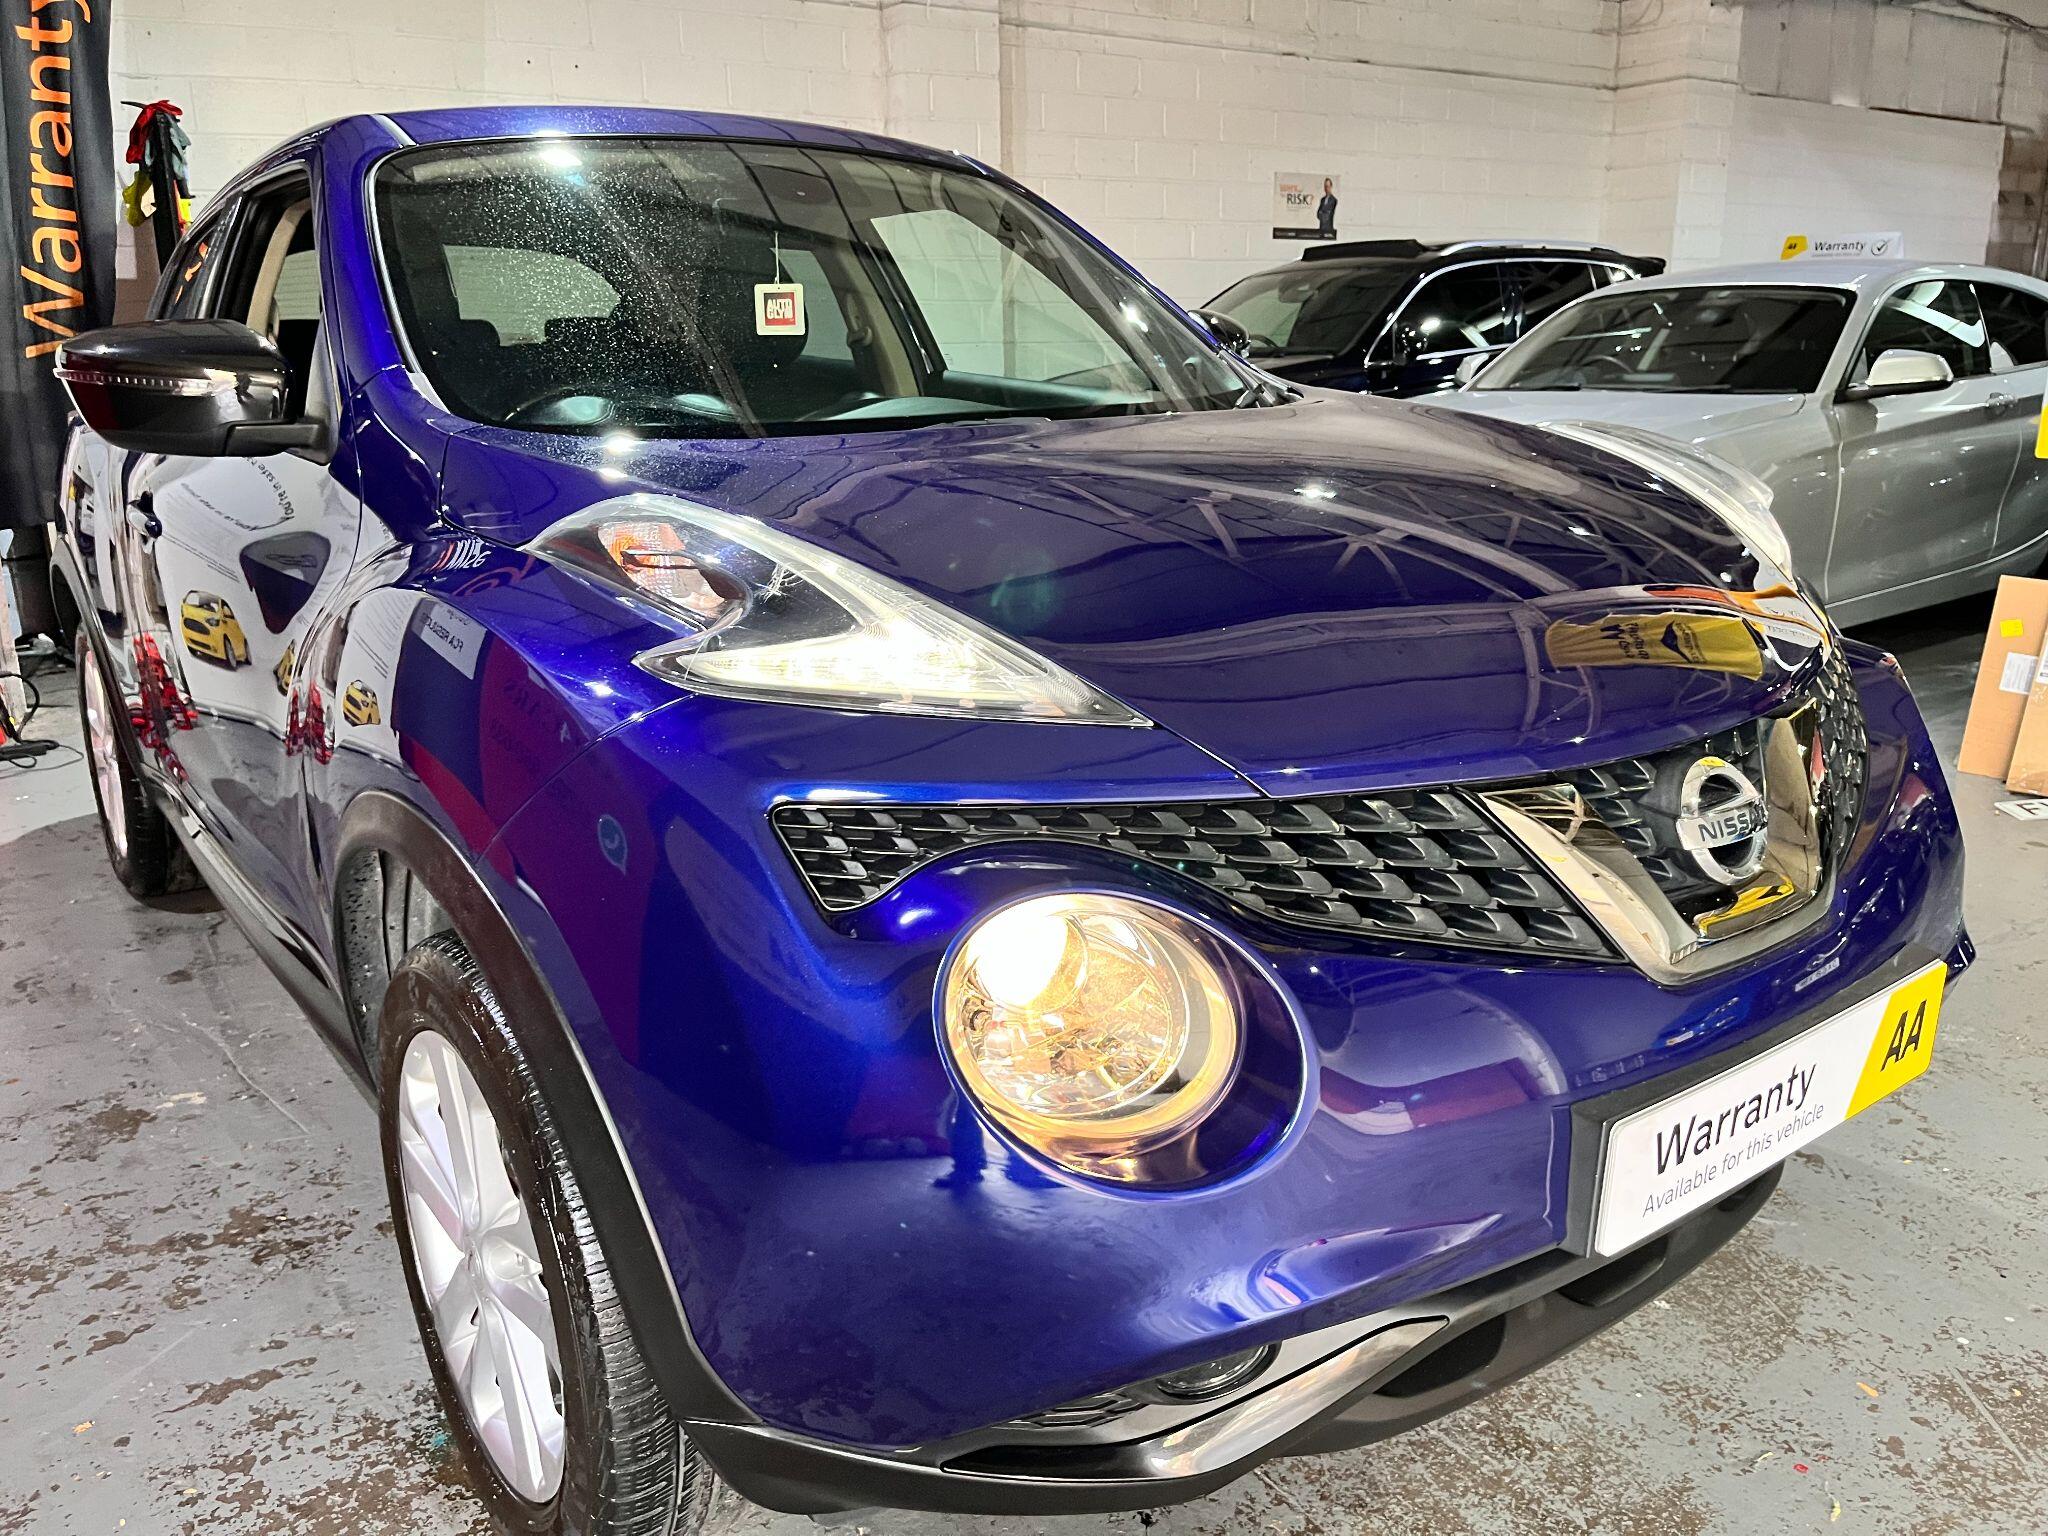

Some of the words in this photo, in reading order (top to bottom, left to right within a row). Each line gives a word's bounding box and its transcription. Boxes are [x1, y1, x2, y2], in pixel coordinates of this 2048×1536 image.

[1286, 193, 1315, 206] RISK?
[1814, 241, 1865, 252] Warranty
[767, 298, 793, 310] AUTO
[1879, 998, 1928, 1073] AA
[1655, 1063, 1817, 1176] Warranty
[1642, 1163, 1717, 1218] Available
[1721, 1152, 1744, 1175] for
[1746, 1132, 1773, 1161] this
[1776, 1103, 1825, 1143] vehicle
